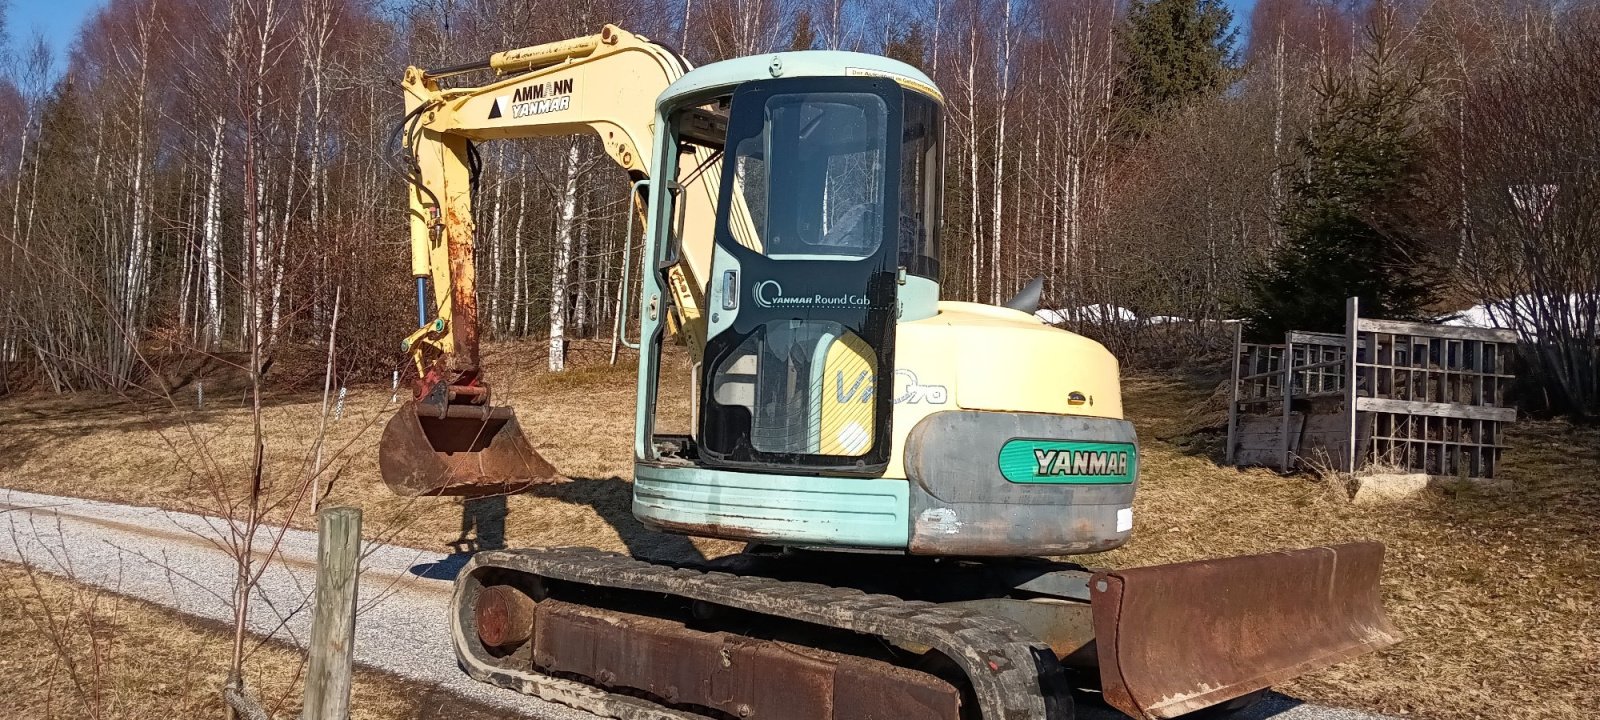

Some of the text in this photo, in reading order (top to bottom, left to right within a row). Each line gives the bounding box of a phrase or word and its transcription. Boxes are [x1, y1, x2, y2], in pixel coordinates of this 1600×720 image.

[512, 78, 573, 103] AMMANN
[512, 96, 570, 119] YANMAR
[815, 294, 847, 304] Round
[849, 295, 870, 305] Cab
[1034, 449, 1127, 476] YANMAR
